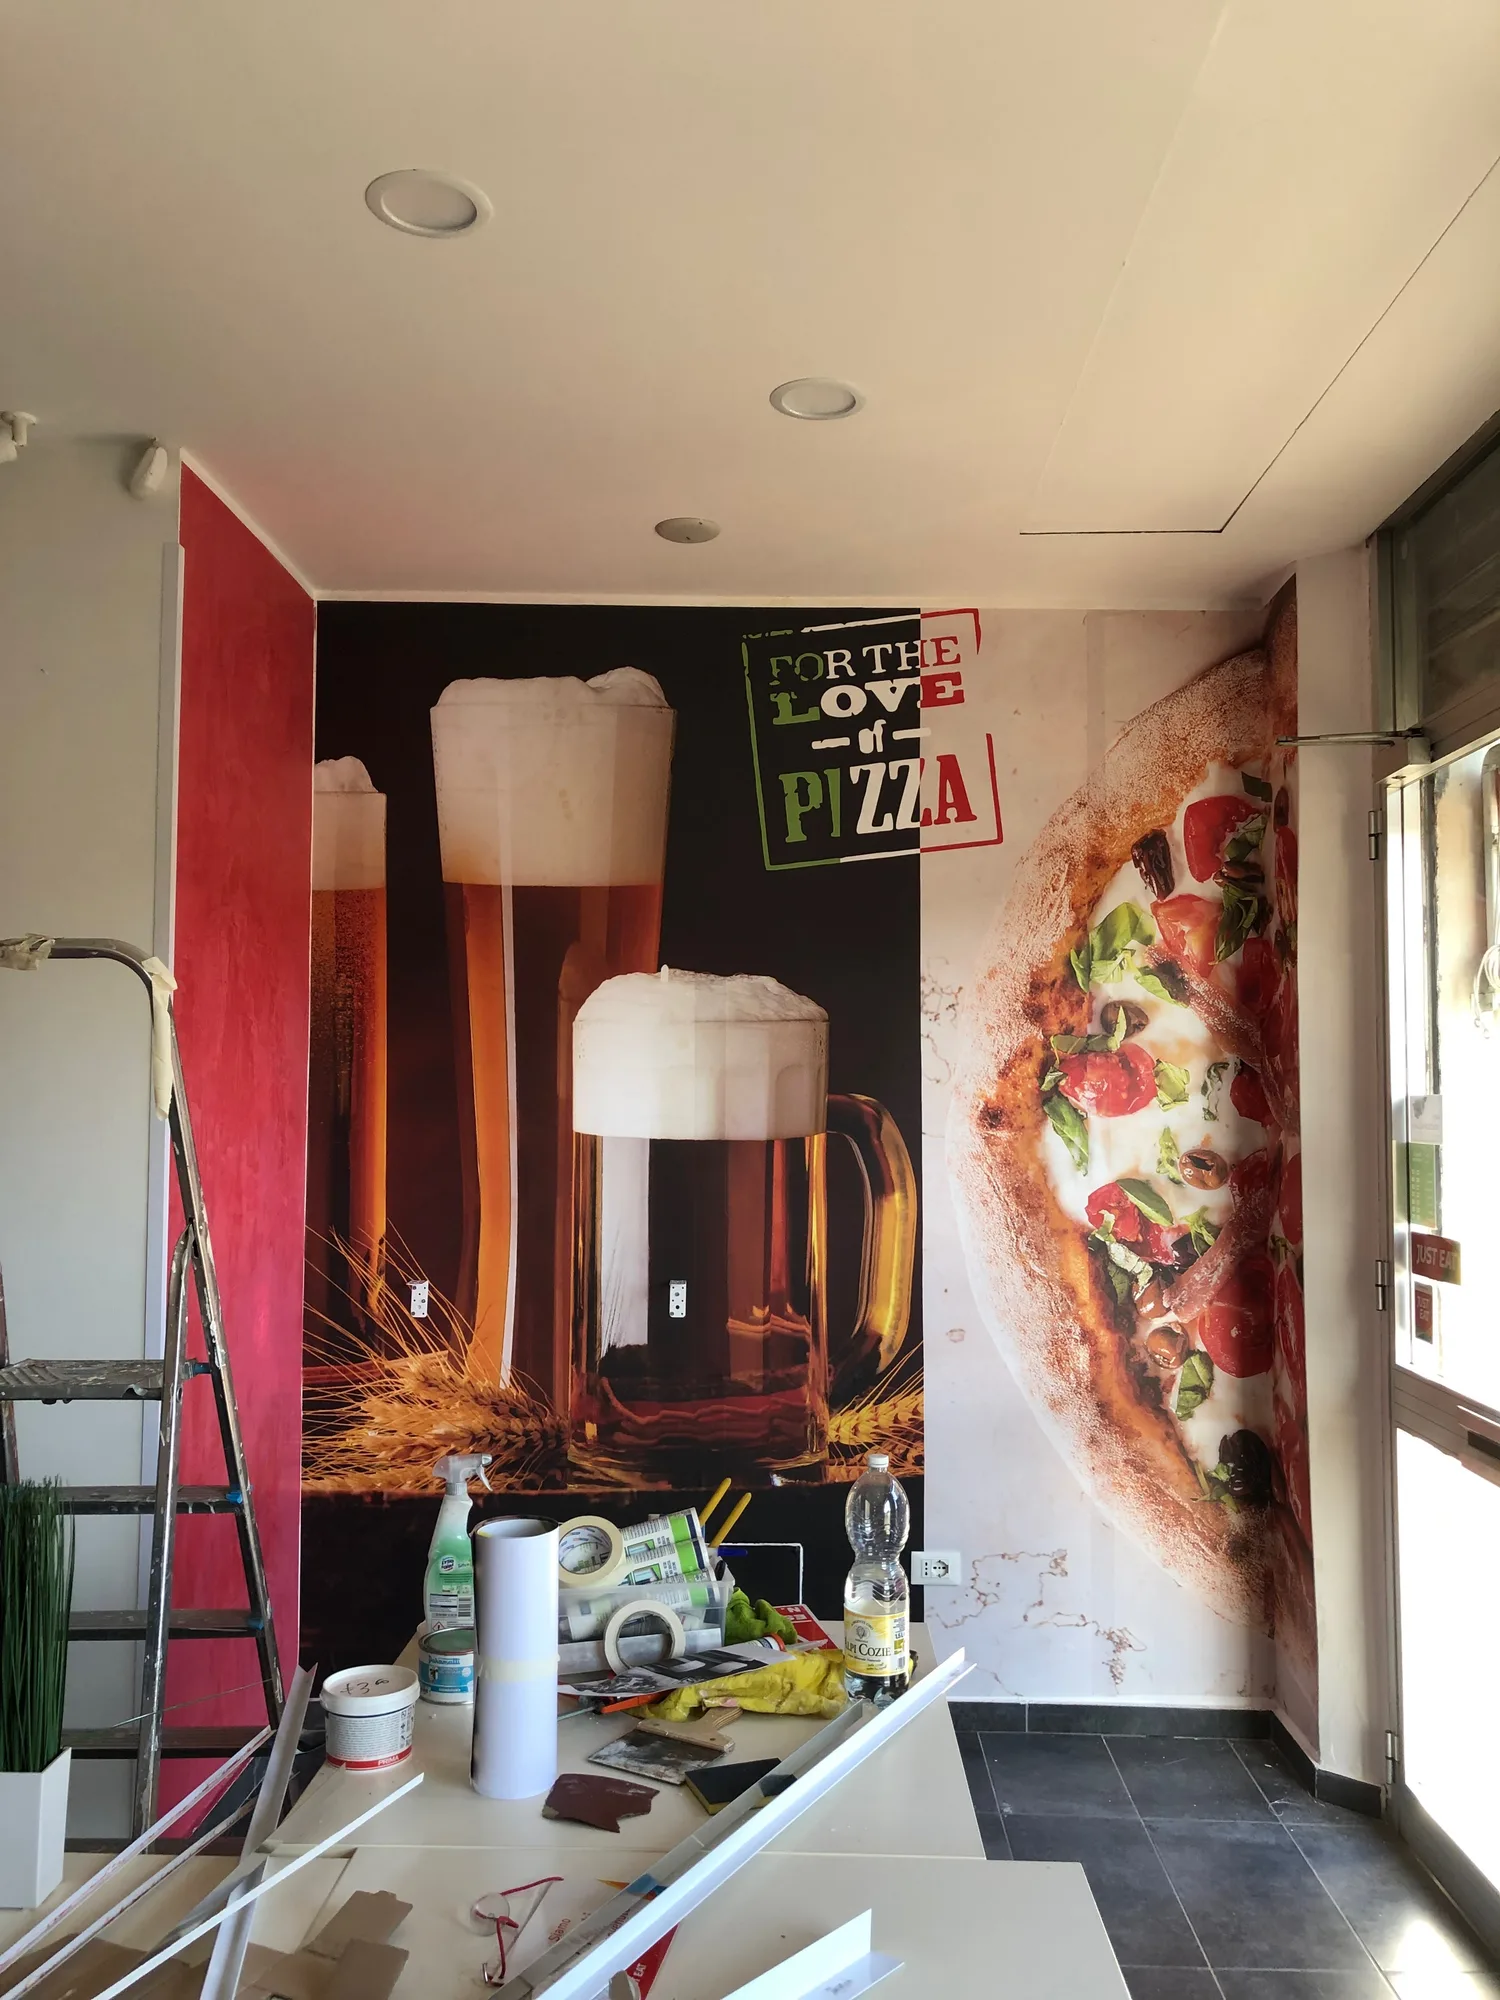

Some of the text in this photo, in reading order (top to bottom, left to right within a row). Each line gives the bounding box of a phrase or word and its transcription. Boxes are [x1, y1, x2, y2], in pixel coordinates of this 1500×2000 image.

[769, 635, 961, 686] FOR THE
[769, 671, 965, 725] LOVE
[858, 718, 887, 754] of
[778, 754, 978, 843] PIZZA
[1416, 1244, 1457, 1270] JUST EAT
[377, 1755, 400, 1766] PRIMA
[548, 1918, 571, 1942] Siamo
